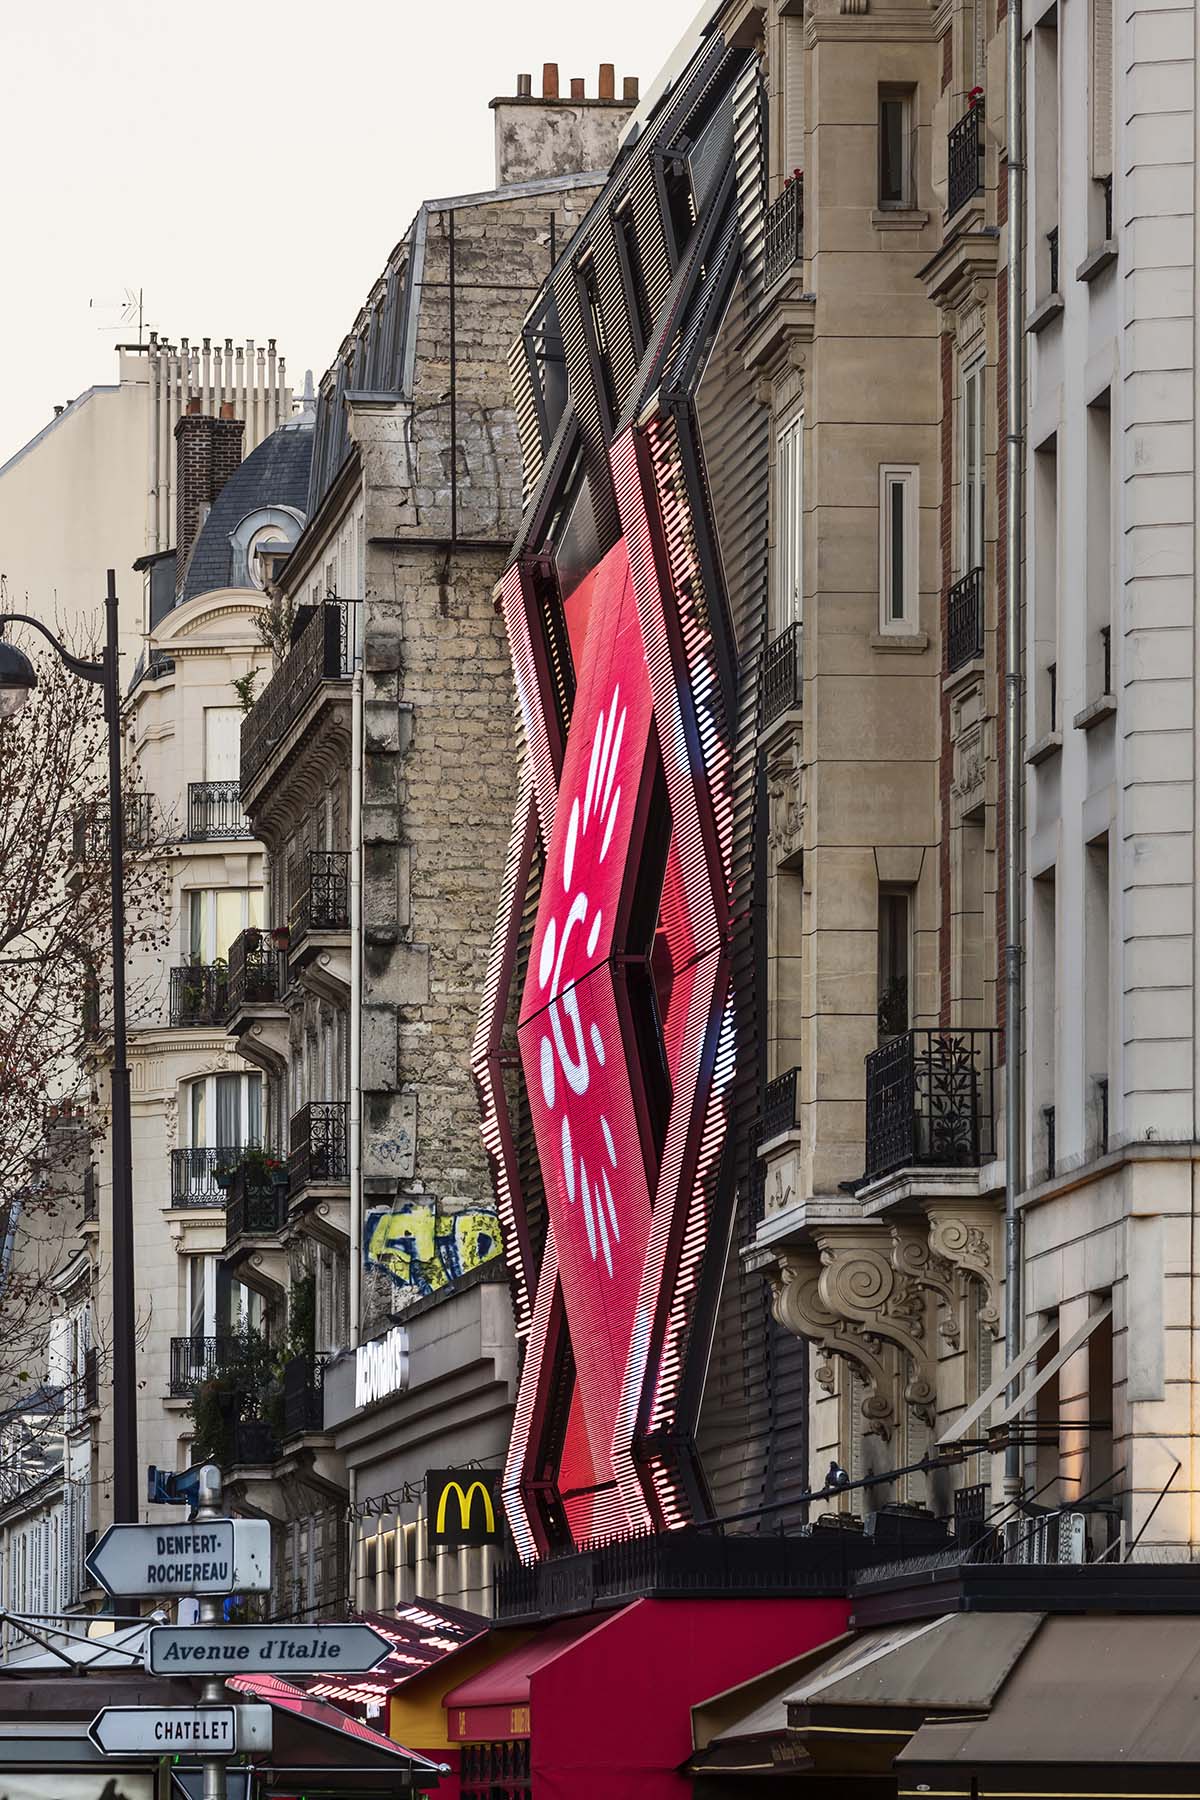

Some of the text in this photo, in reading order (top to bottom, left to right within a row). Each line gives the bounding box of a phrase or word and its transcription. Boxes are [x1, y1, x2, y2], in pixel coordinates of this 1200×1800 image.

[156, 1534, 222, 1556] DENFERT-
[147, 1562, 229, 1584] ROCHEREAU
[163, 1639, 341, 1661] Avenue d'Italie
[154, 1721, 229, 1740] CHATELET
